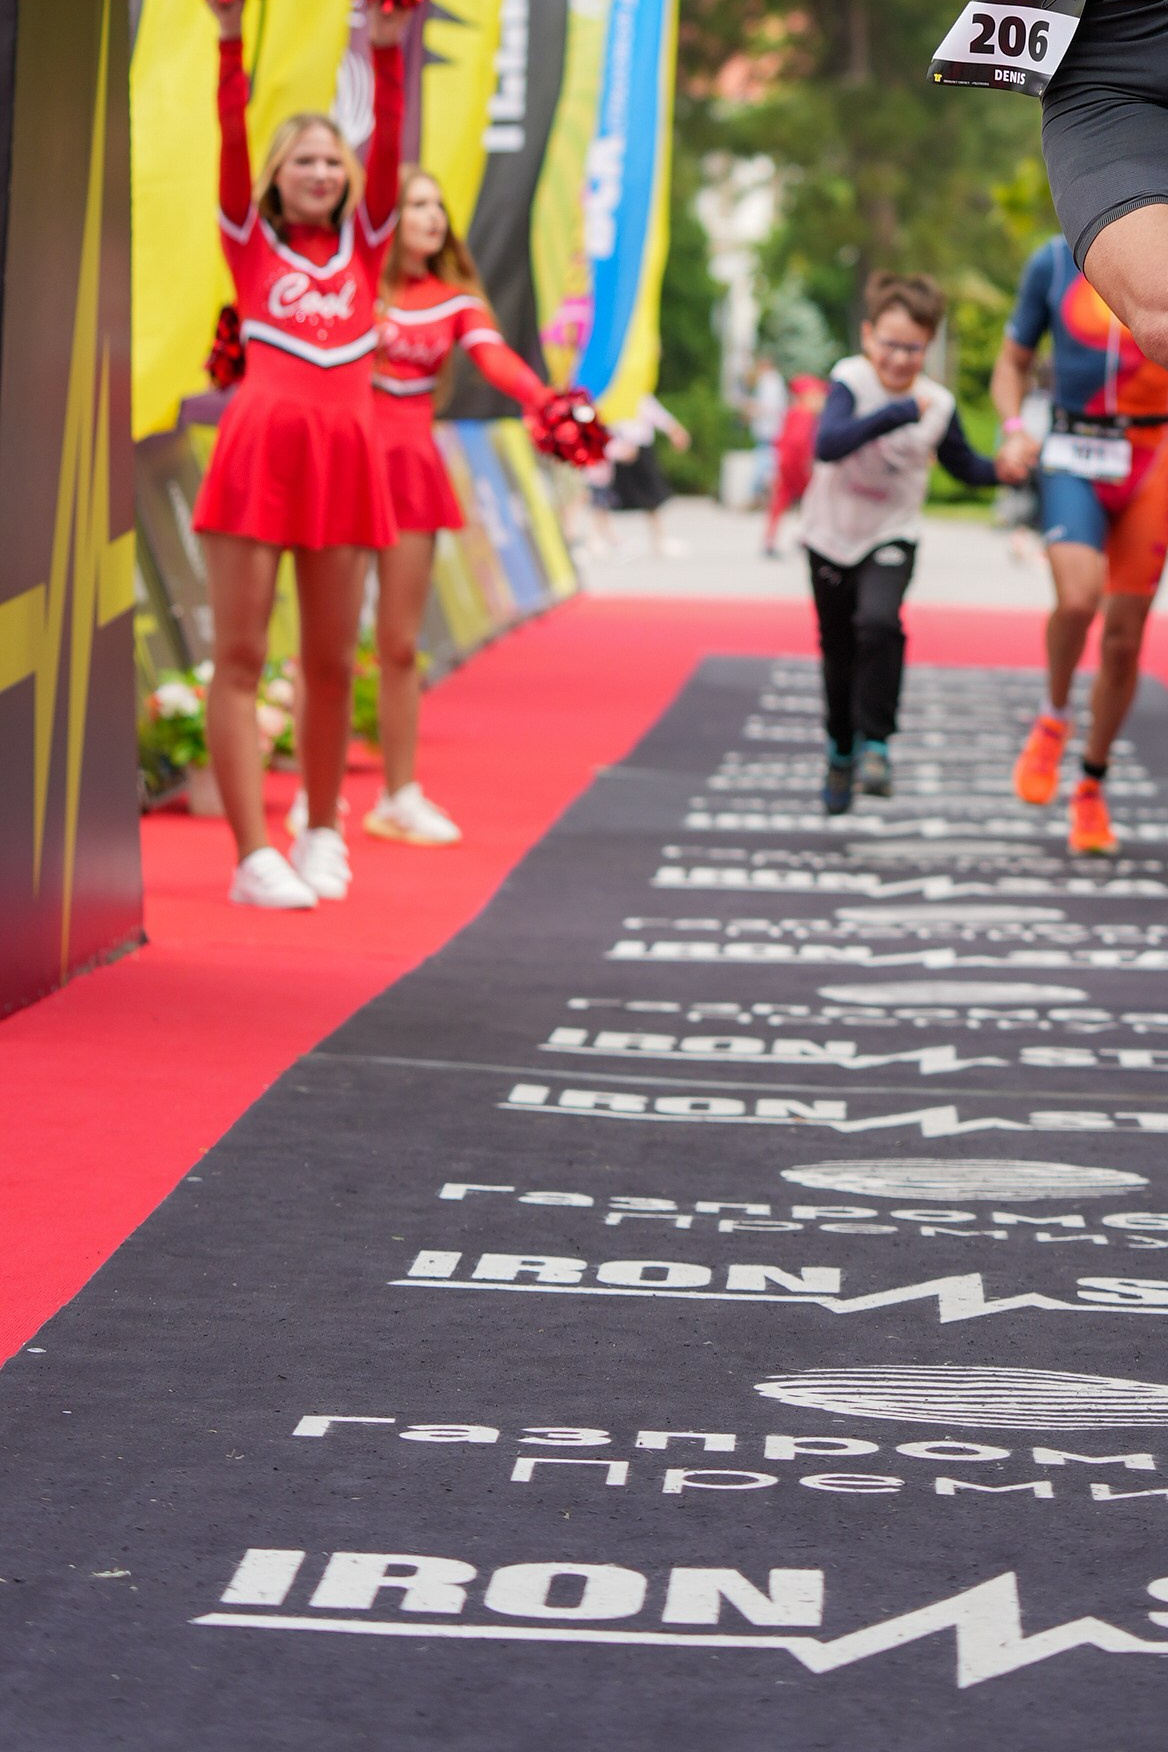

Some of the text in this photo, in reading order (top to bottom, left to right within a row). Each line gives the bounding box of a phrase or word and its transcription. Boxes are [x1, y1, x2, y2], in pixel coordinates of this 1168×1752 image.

[969, 13, 1051, 63] 206
[994, 68, 1027, 85] DENIS
[547, 1027, 857, 1060] IRON
[508, 1084, 847, 1120] IRON
[406, 1250, 842, 1294] IRON
[219, 1548, 825, 1628] IRON
